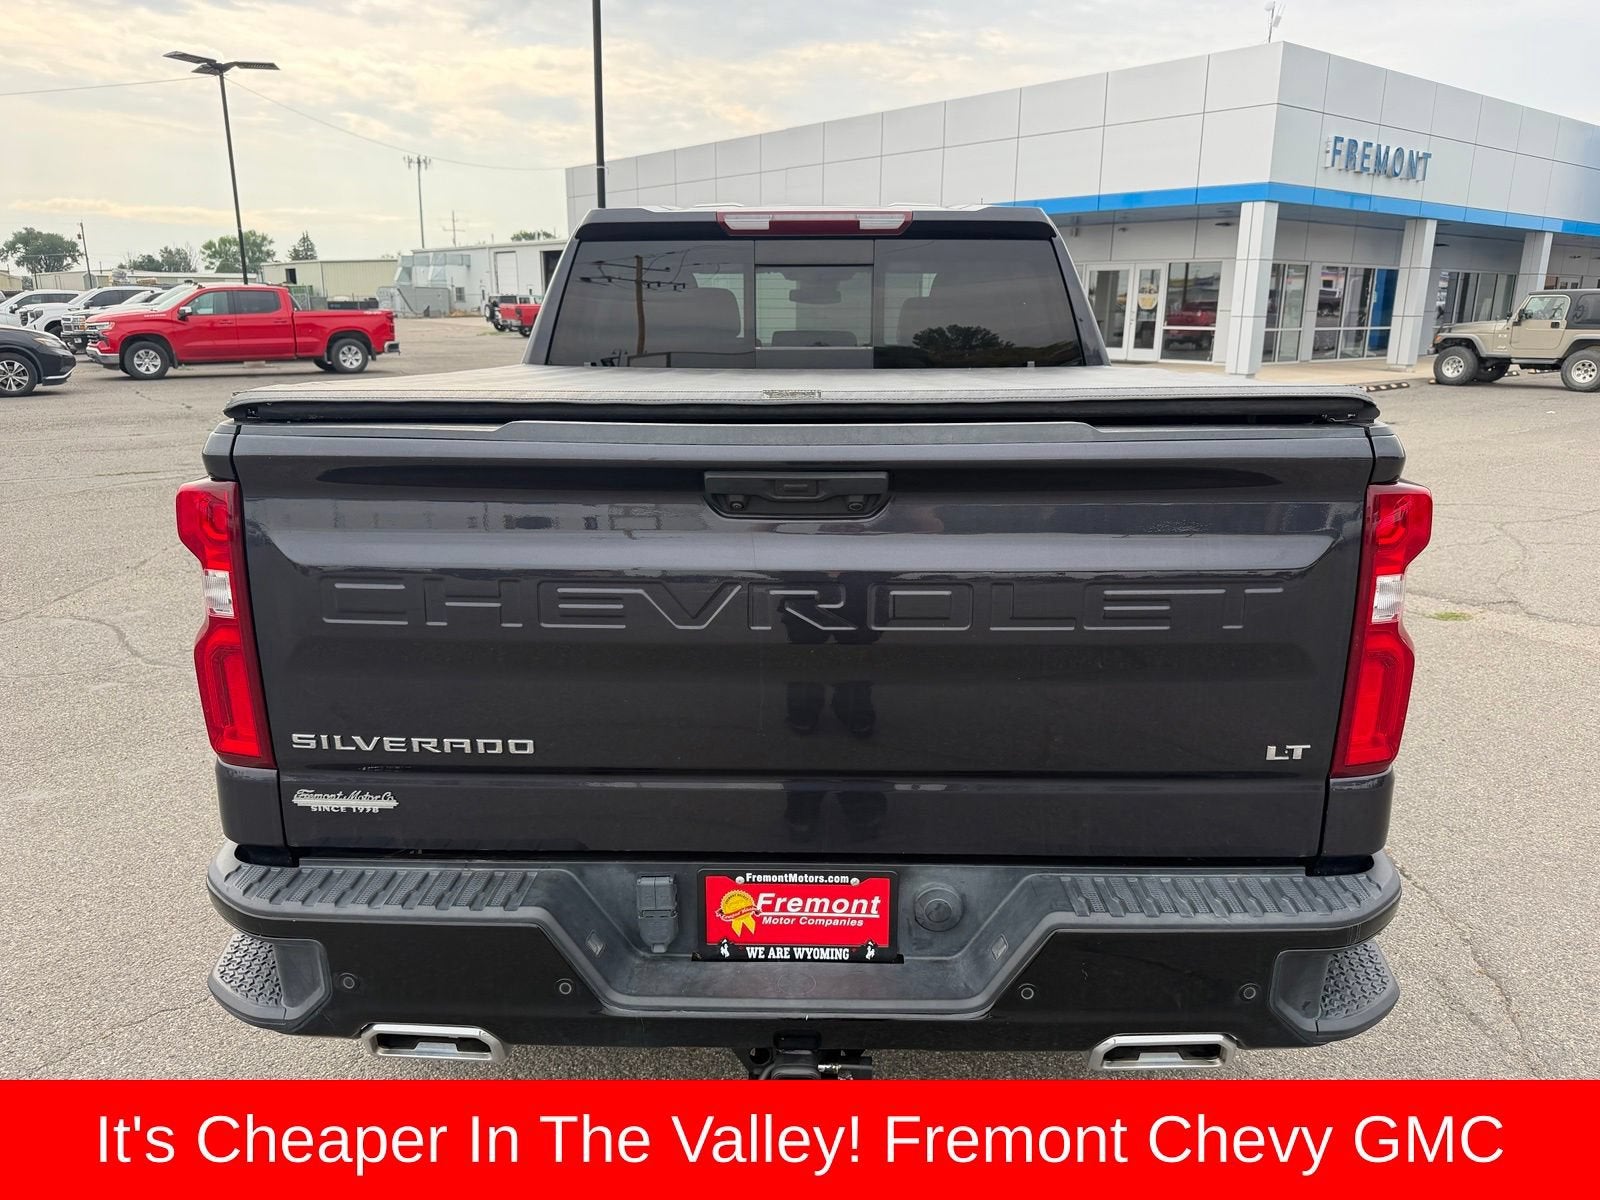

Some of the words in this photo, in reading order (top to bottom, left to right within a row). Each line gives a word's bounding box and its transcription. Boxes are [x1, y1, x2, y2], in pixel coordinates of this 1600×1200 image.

[1328, 135, 1432, 182] FREMONT
[320, 576, 1285, 632] CHEVROLET
[291, 733, 535, 755] SILVERADO
[1265, 744, 1311, 761] LT
[310, 805, 348, 813] SINCE
[745, 873, 849, 885] FremontMotors.com
[756, 892, 882, 915] Fremont
[762, 916, 796, 926] Motor
[799, 916, 864, 928] Companies
[746, 946, 765, 959] WE
[768, 947, 790, 959] ARE
[793, 947, 850, 961] WYOMING
